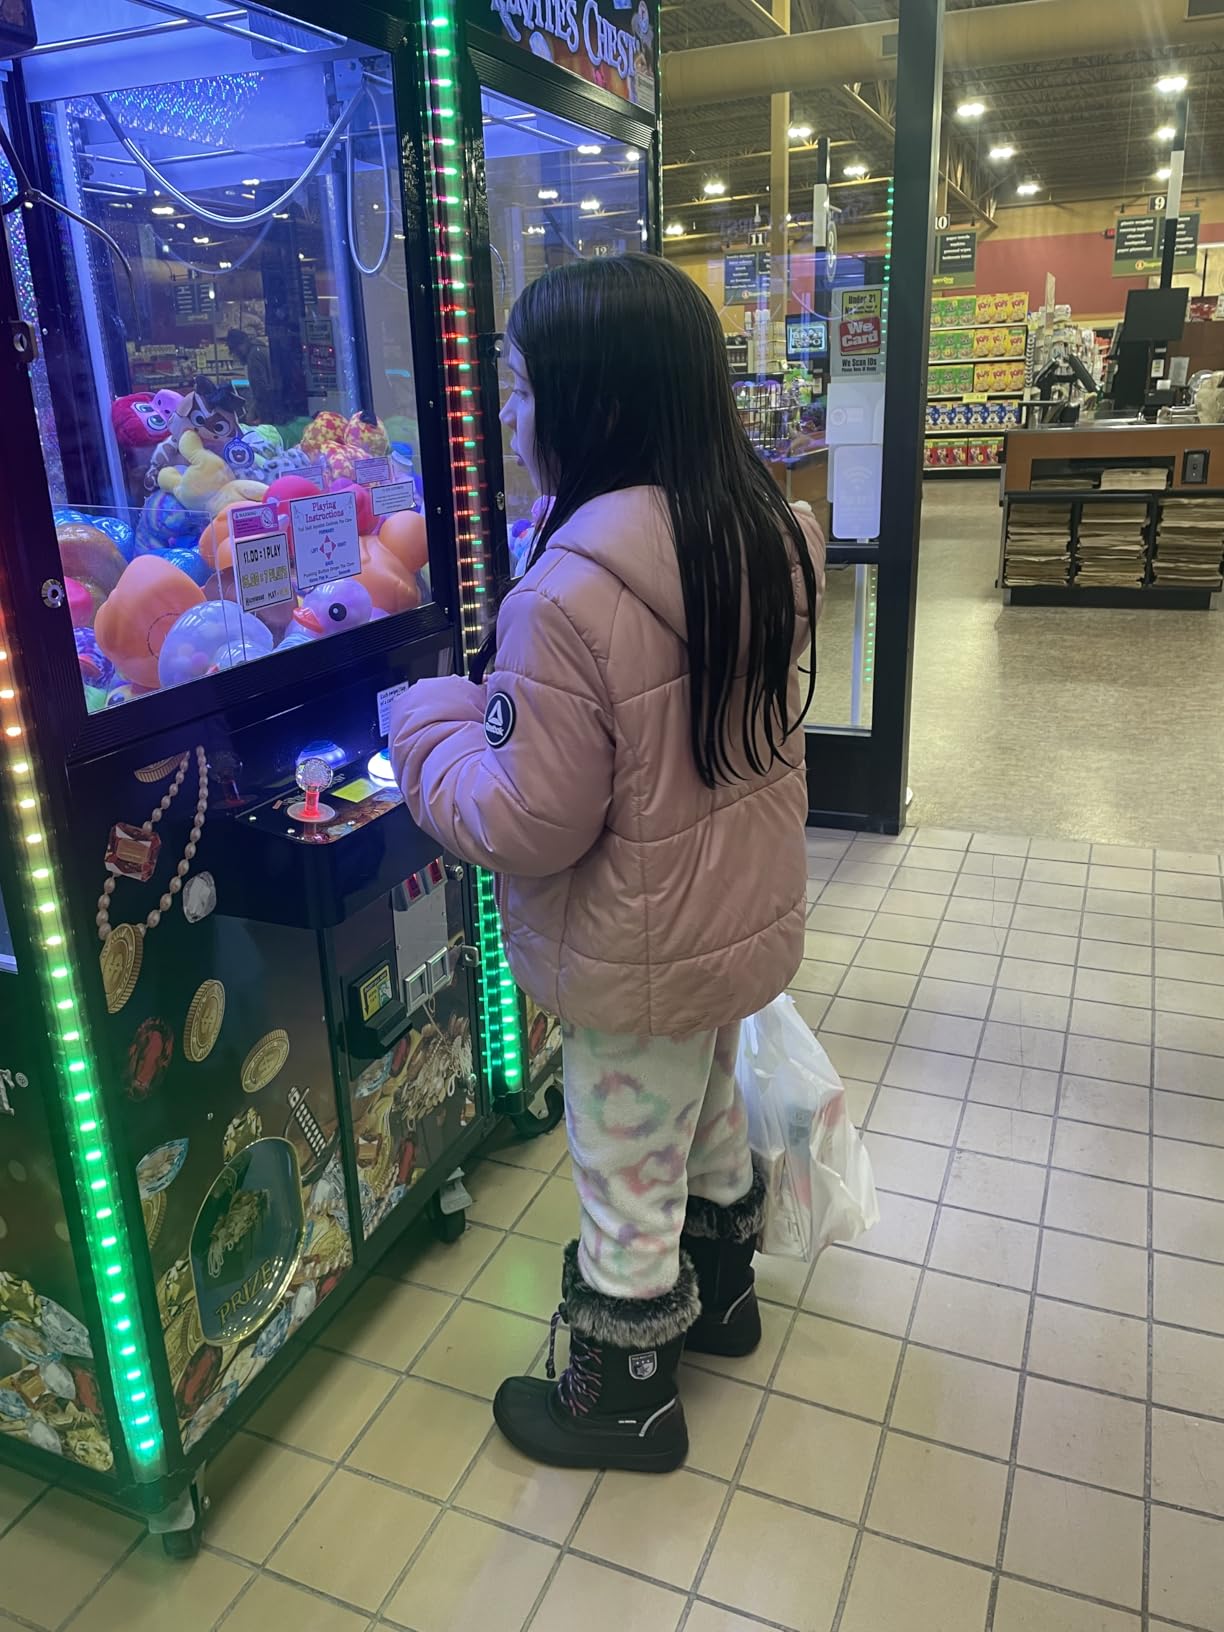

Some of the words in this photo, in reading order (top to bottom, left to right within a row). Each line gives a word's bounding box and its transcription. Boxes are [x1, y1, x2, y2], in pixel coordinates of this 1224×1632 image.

[583, 0, 636, 79] CHEST
[1155, 196, 1165, 210] 9
[750, 233, 764, 246] 11
[849, 294, 867, 304] Under
[868, 294, 876, 302] 21
[847, 321, 874, 334] We
[842, 330, 879, 347] Card
[842, 359, 851, 367] We
[852, 358, 866, 367] Scan
[867, 357, 877, 366] IDs
[312, 500, 337, 511] Playing
[305, 509, 344, 523] Instructions
[267, 544, 281, 560] PLAY
[216, 1260, 273, 1326] PRIZE
